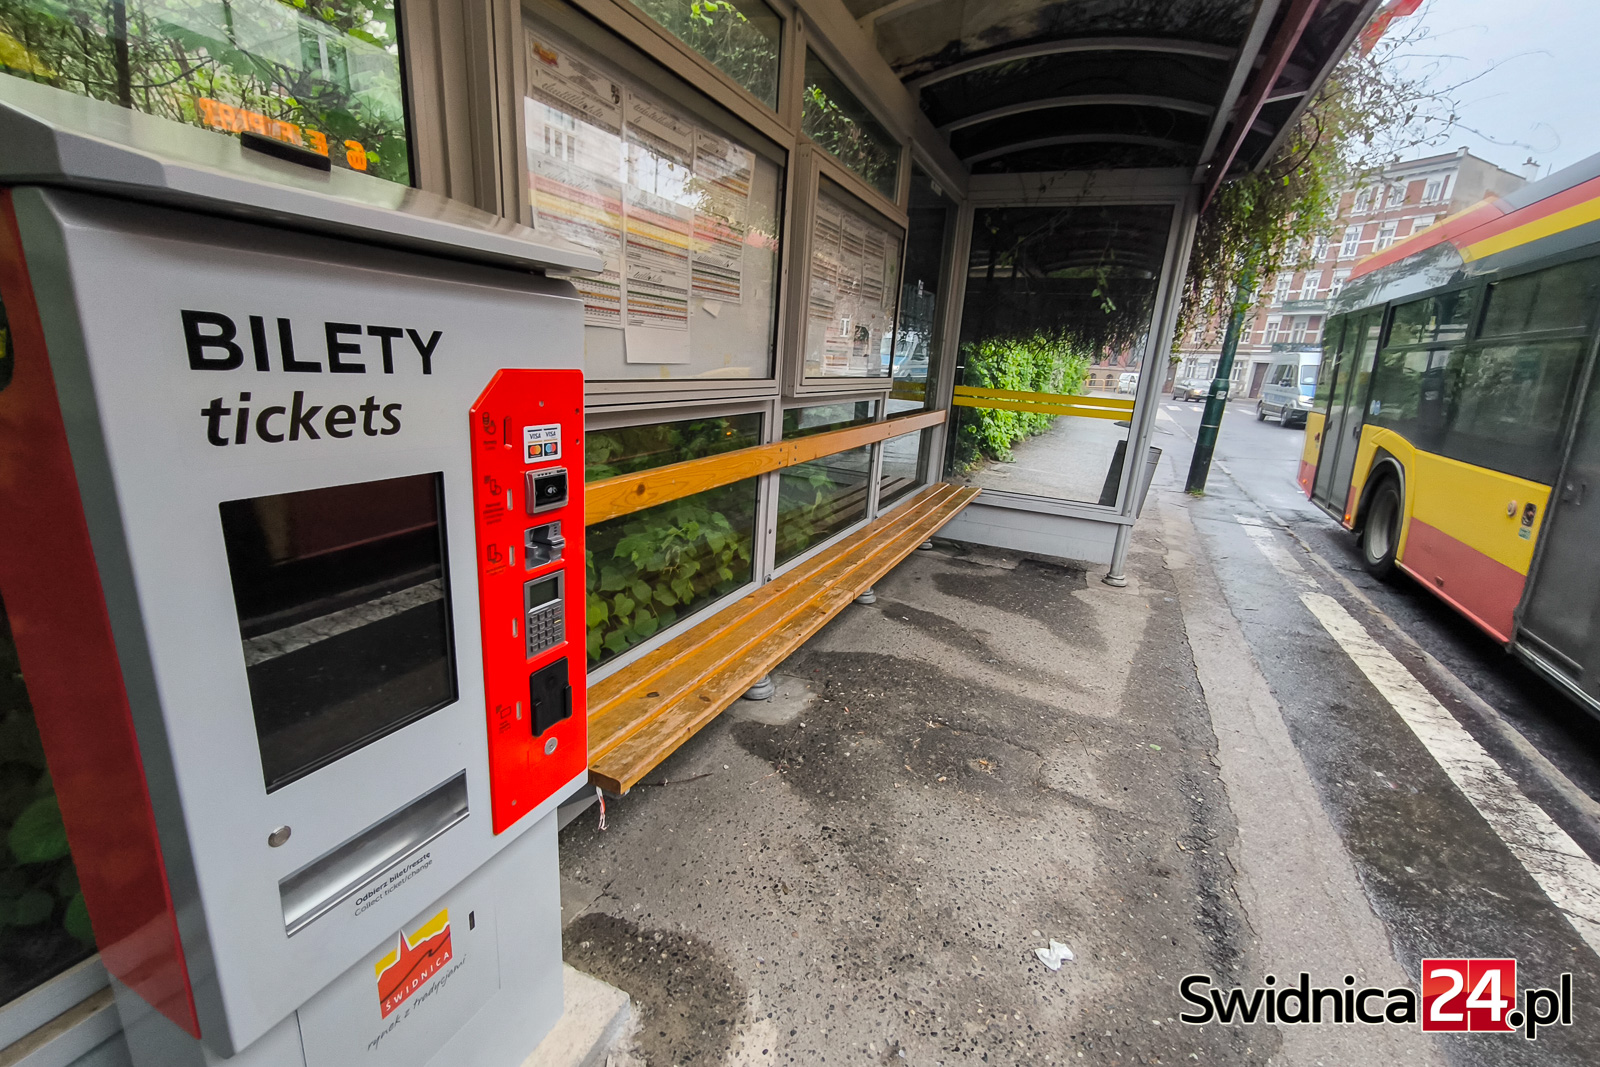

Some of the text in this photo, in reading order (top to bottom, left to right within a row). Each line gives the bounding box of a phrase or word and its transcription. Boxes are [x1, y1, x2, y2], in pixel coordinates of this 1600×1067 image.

[180, 309, 443, 375] BILETY
[200, 391, 403, 447] tickets
[529, 432, 542, 440] VISA
[545, 430, 557, 438] VISA
[354, 859, 433, 917] Collect ticket/change
[355, 852, 431, 906] Odbierz bilet/resztę
[367, 953, 467, 1052] rynek z tradycjami
[385, 951, 450, 1012] ŚWIDNICA
